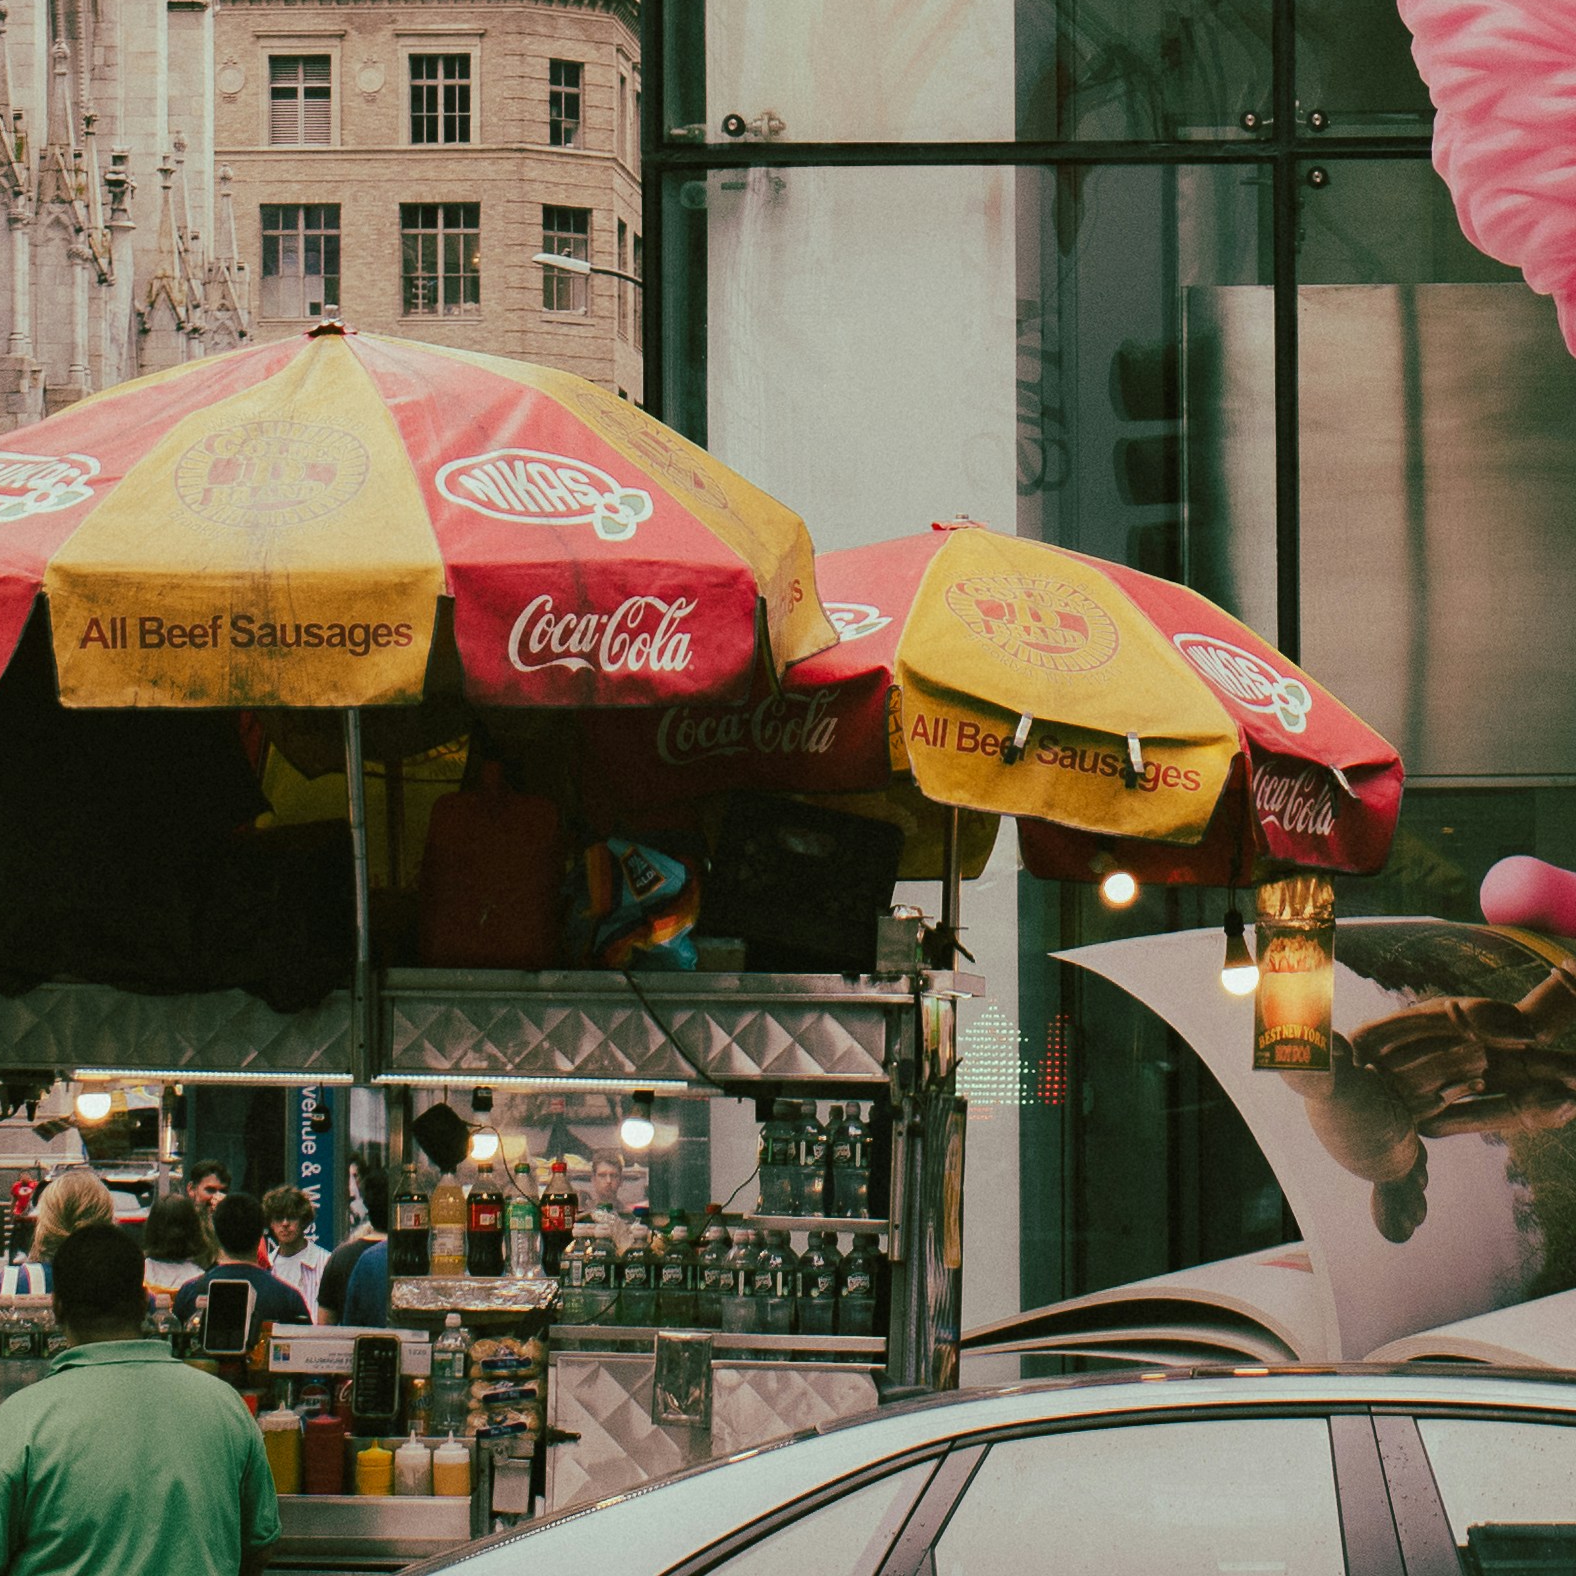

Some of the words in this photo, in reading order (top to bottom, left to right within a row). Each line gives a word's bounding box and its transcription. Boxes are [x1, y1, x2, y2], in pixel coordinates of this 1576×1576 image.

[457, 458, 600, 514] NIKAS
[78, 616, 128, 650] All
[138, 614, 223, 650] Beef
[229, 613, 414, 658] Sausages
[507, 594, 699, 672] Coca-Cola
[656, 689, 841, 765] Coca-Cola
[910, 713, 949, 749] All
[1258, 1025, 1282, 1049] BEST
[1282, 1024, 1303, 1039] NEW
[1303, 1025, 1328, 1053] YORK
[300, 1086, 318, 1155] venue
[300, 1161, 322, 1178] &
[301, 1184, 322, 1242] Wst
